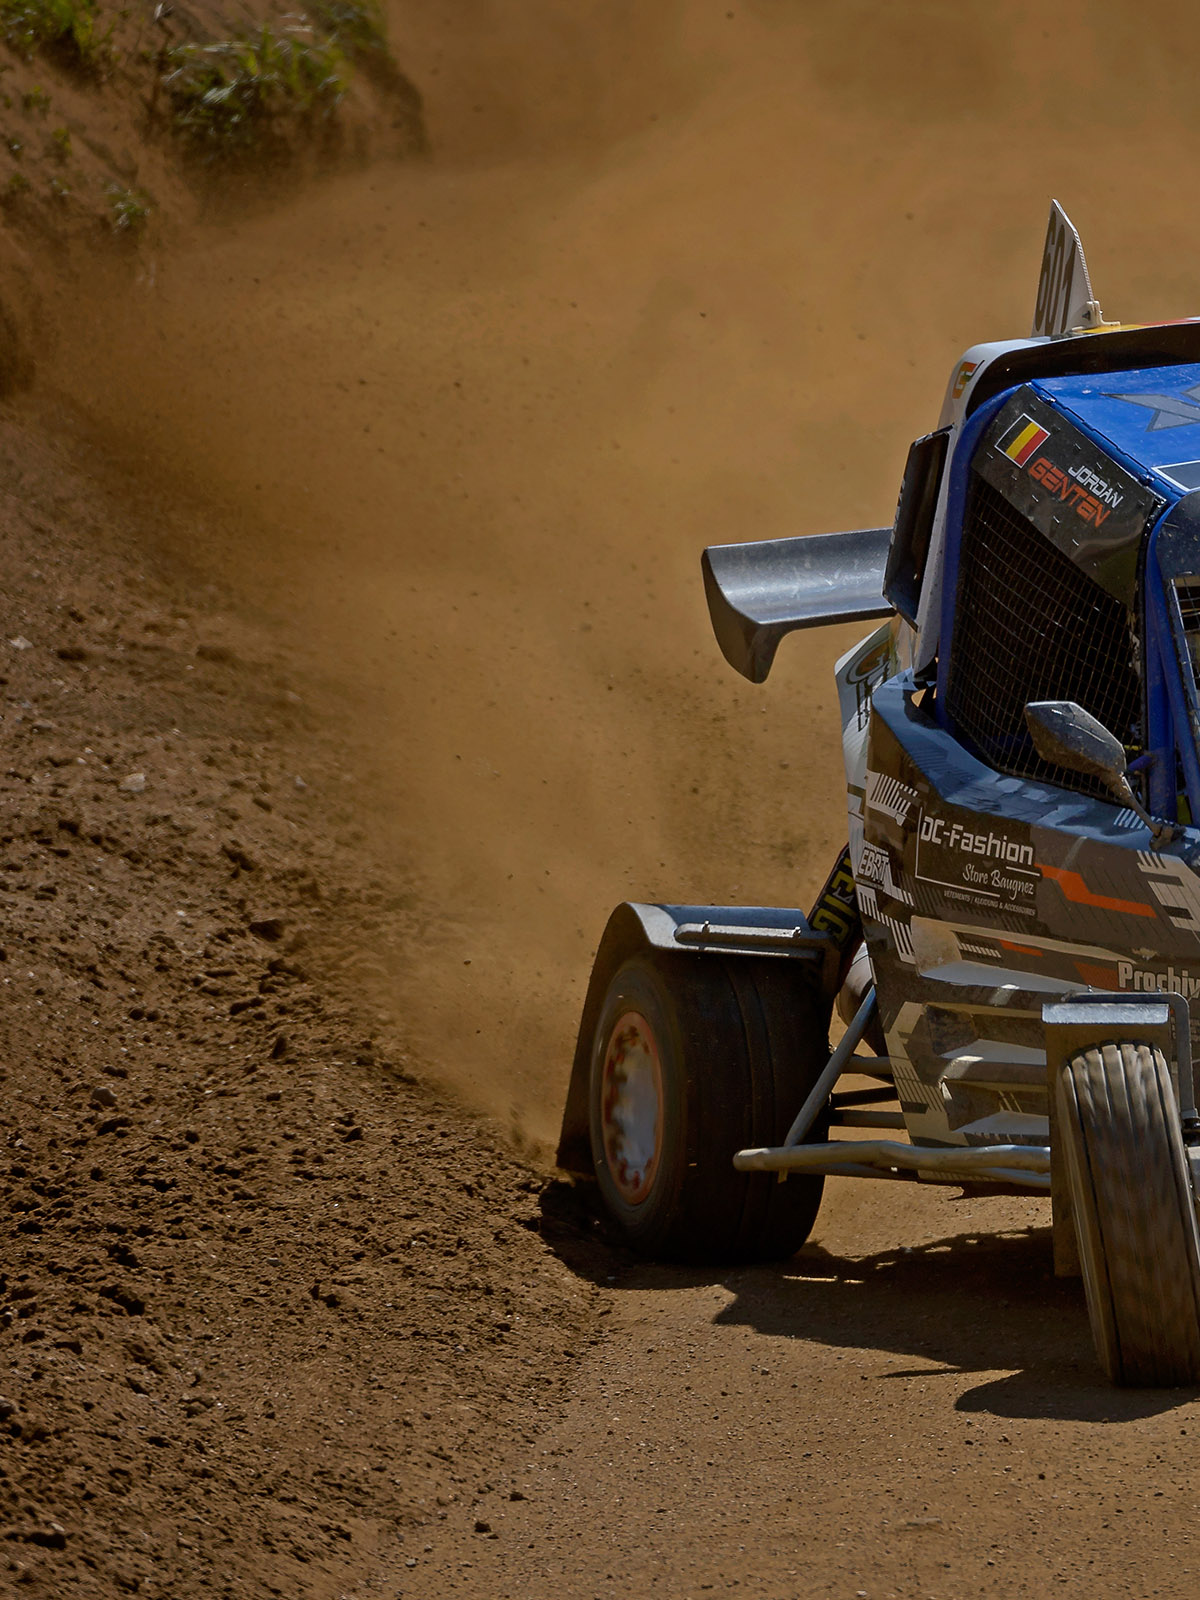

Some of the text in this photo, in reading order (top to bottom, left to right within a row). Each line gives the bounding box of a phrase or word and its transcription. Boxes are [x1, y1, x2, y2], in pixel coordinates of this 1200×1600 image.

[1028, 457, 1111, 528] GENTEN
[1067, 465, 1124, 508] JORDAN
[920, 815, 1034, 866] DC-Fashion
[962, 863, 1034, 901] Store Baugnez
